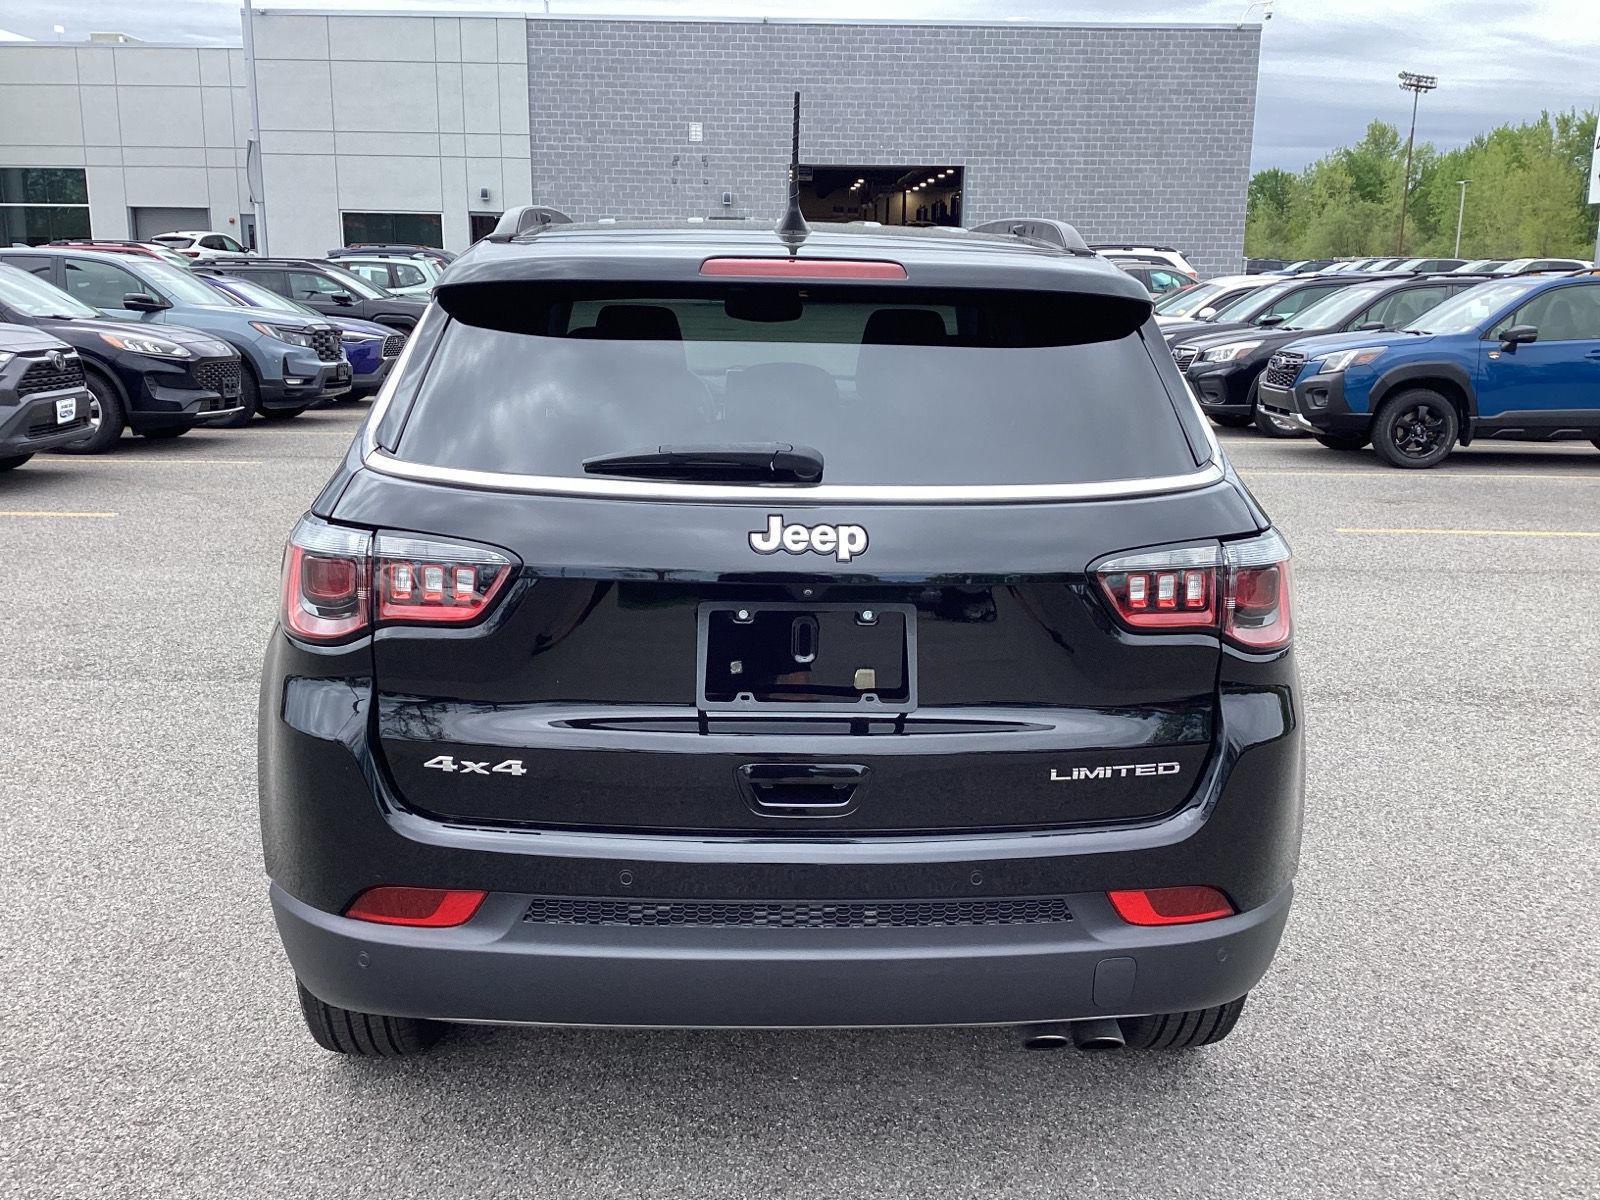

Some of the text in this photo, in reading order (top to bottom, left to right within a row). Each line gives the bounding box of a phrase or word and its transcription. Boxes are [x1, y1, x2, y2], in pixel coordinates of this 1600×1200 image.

[749, 514, 869, 561] Jeep
[423, 755, 527, 776] 4x4
[1050, 762, 1180, 781] LIMITED
